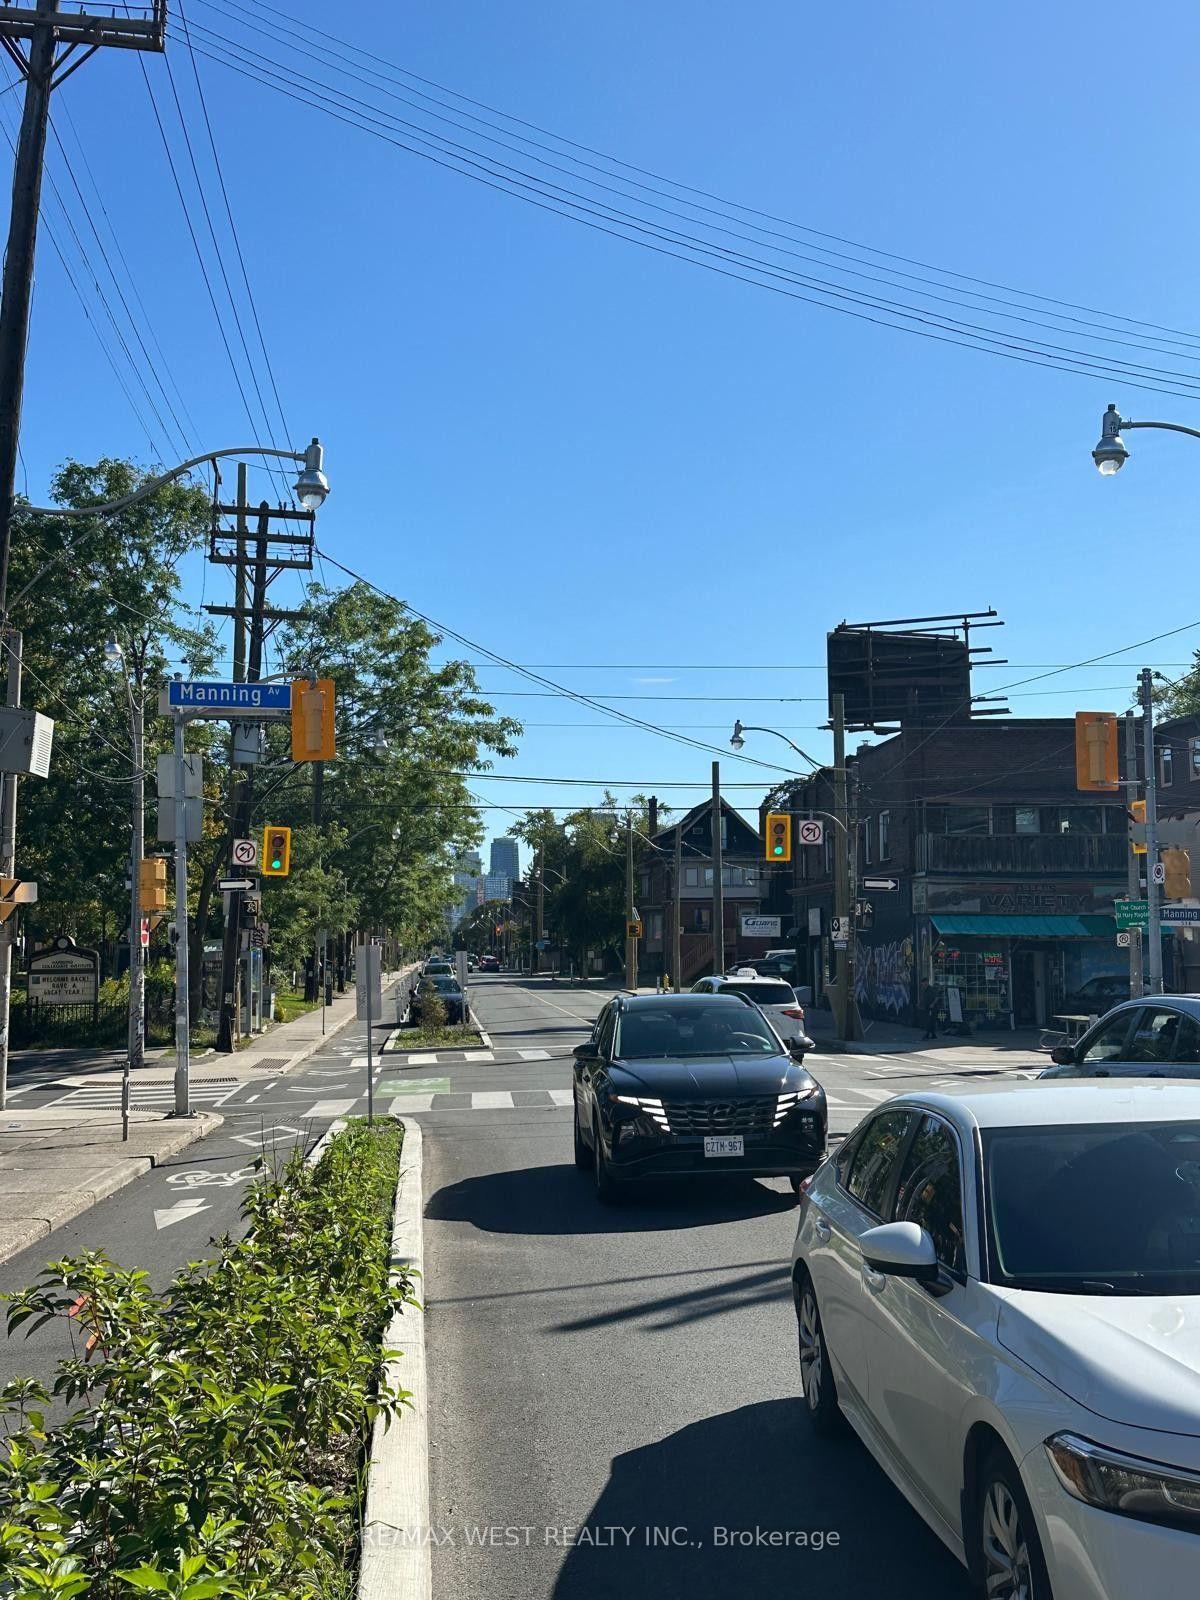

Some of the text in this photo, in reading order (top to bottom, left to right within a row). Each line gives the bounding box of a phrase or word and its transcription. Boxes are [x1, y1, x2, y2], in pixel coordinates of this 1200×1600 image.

[180, 683, 280, 706] Manning Av
[986, 894, 1089, 906] VARIETY
[1163, 908, 1198, 920] Manning
